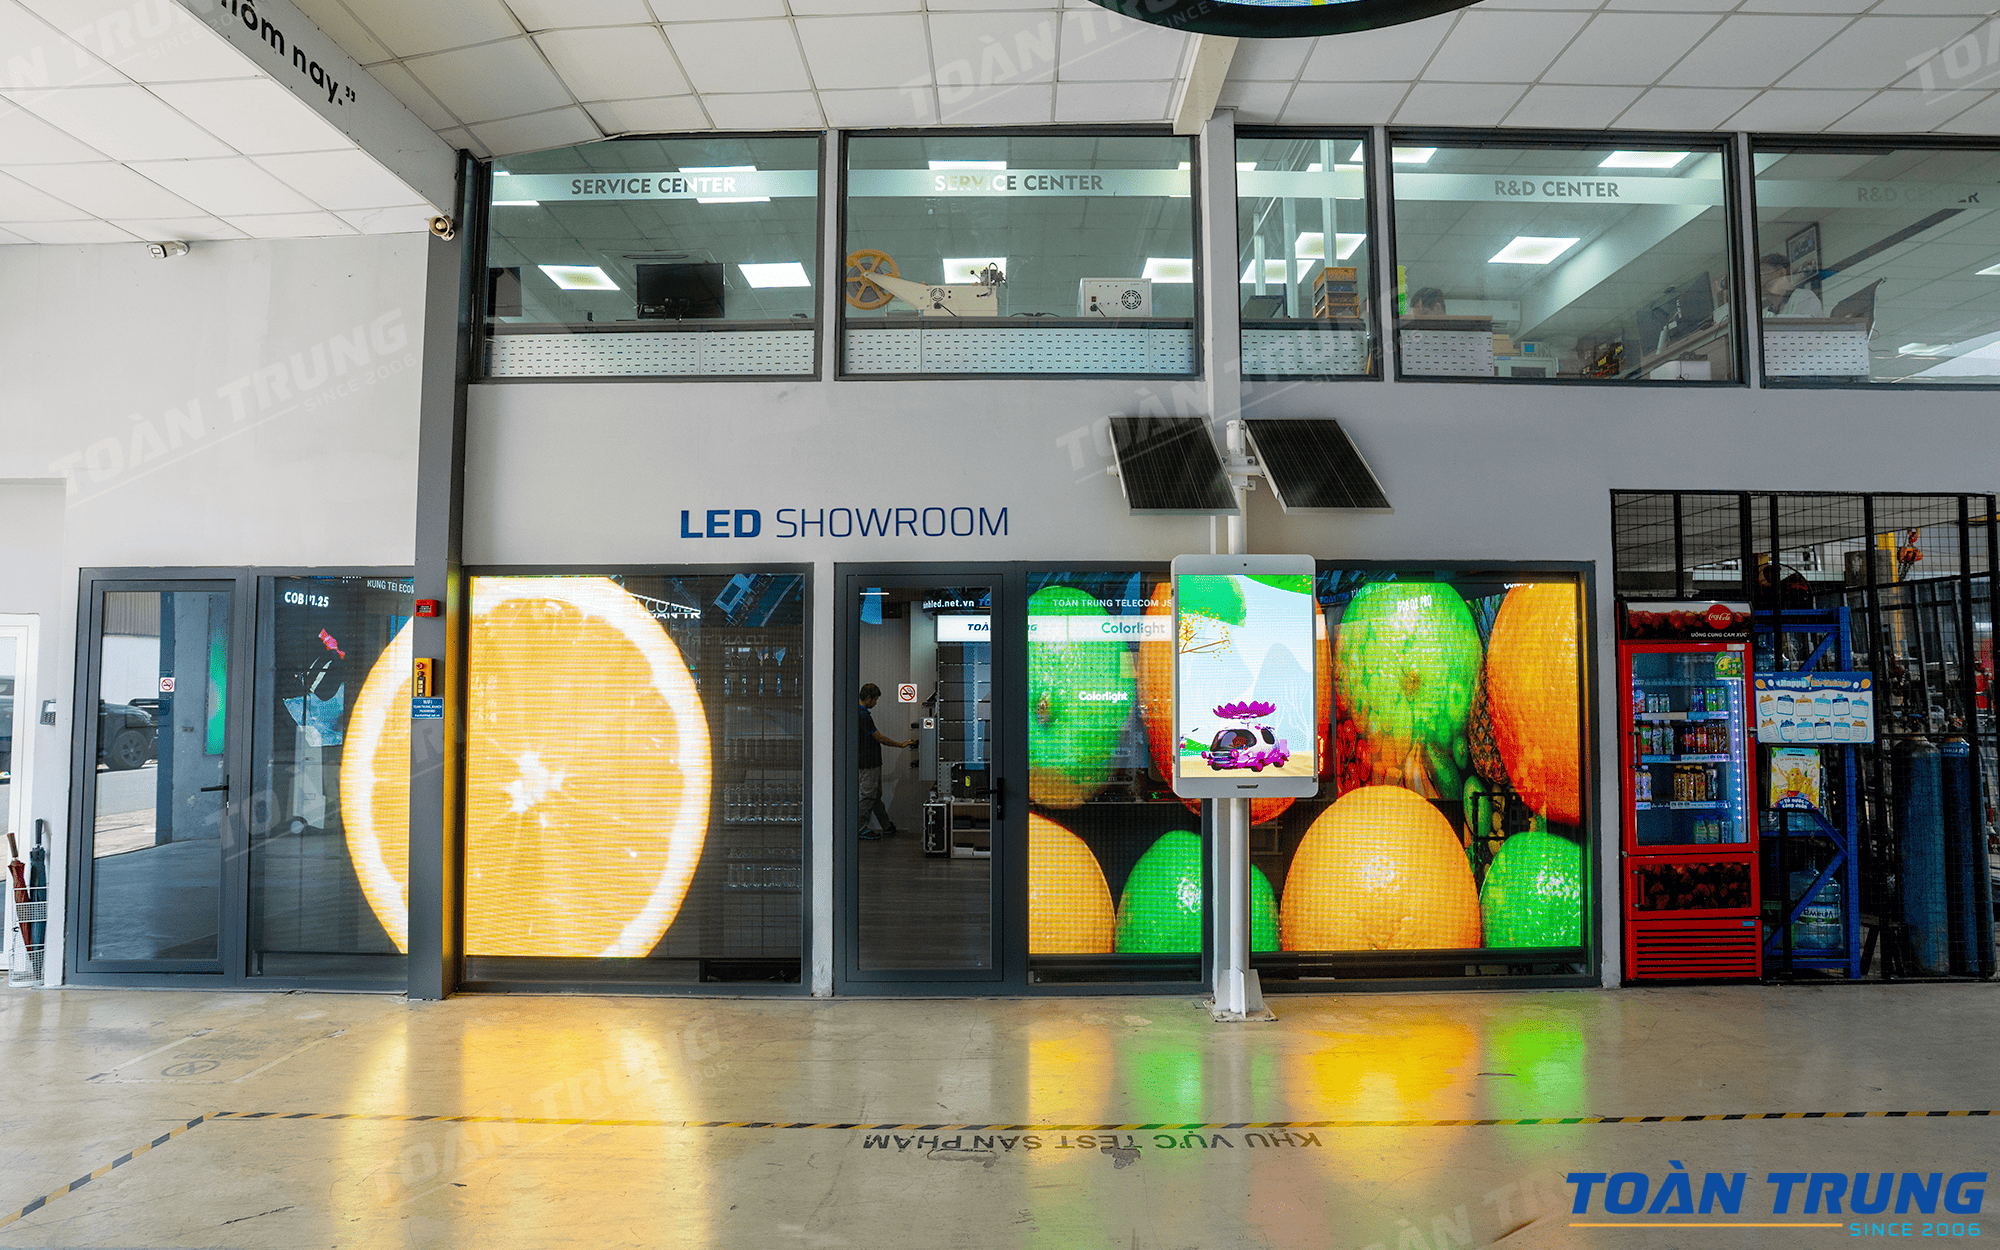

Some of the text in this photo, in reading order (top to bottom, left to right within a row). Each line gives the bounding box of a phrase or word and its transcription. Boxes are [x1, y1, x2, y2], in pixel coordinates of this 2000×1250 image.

[571, 177, 736, 194] SERVICE CENTER
[934, 175, 1103, 191] SERVICE CENTER
[1494, 180, 1620, 197] R&D CENTER
[681, 507, 1008, 538] LED SHOWROOM
[284, 591, 304, 605] COB
[1082, 599, 1113, 607] TRUNG
[1115, 599, 1159, 607] TELECOM
[1101, 622, 1165, 636] Colorlight
[1811, 678, 1849, 689] Birthday
[1078, 691, 1128, 703] Colorlight
[1054, 1134, 1136, 1149] TEST
[1245, 1131, 1323, 1149] KHU
